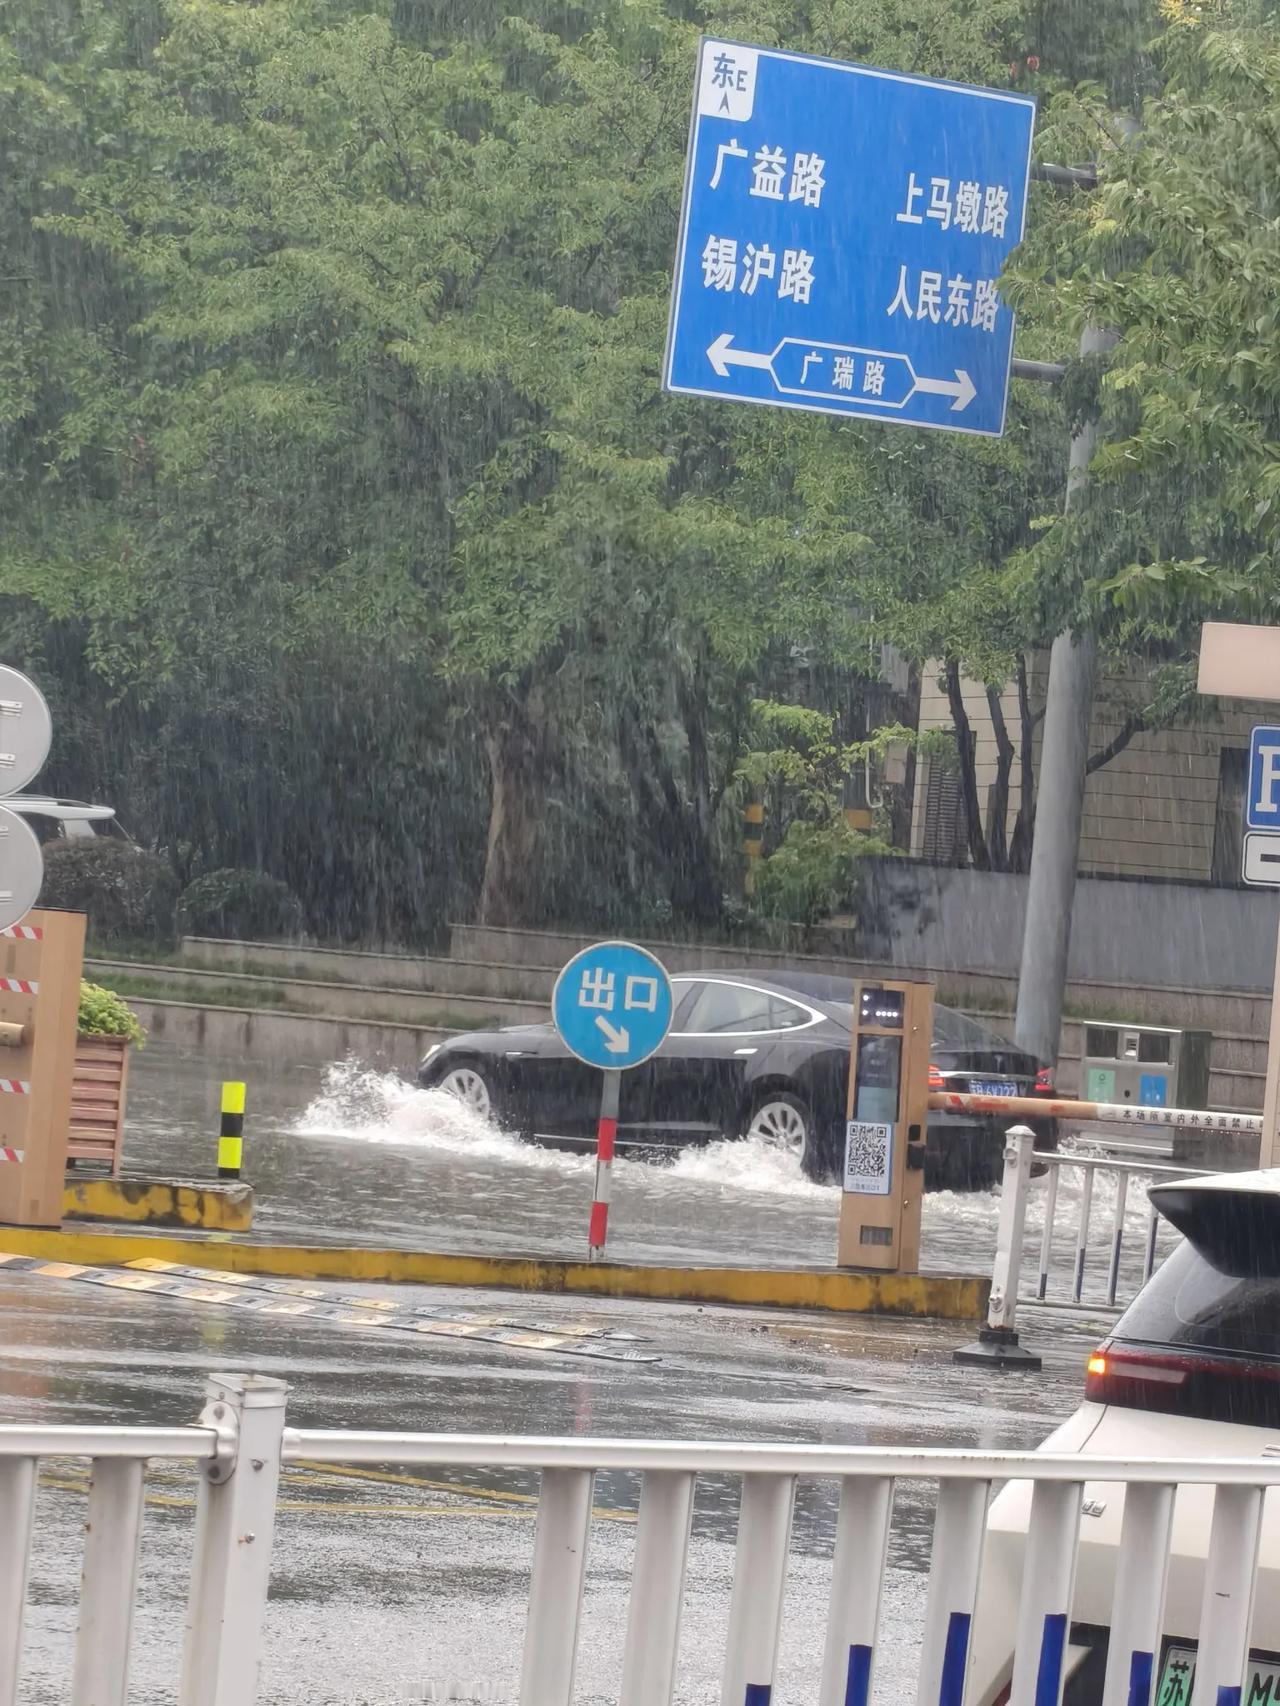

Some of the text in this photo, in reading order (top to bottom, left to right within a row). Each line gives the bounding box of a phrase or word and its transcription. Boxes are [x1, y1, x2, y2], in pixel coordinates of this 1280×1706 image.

[709, 138, 826, 208] 广益路
[896, 172, 1010, 239] 上马墩路
[701, 235, 816, 305] 锡沪路
[886, 265, 1001, 333] 人民东路
[800, 351, 886, 396] 广瑞路
[578, 967, 658, 1013] 出口
